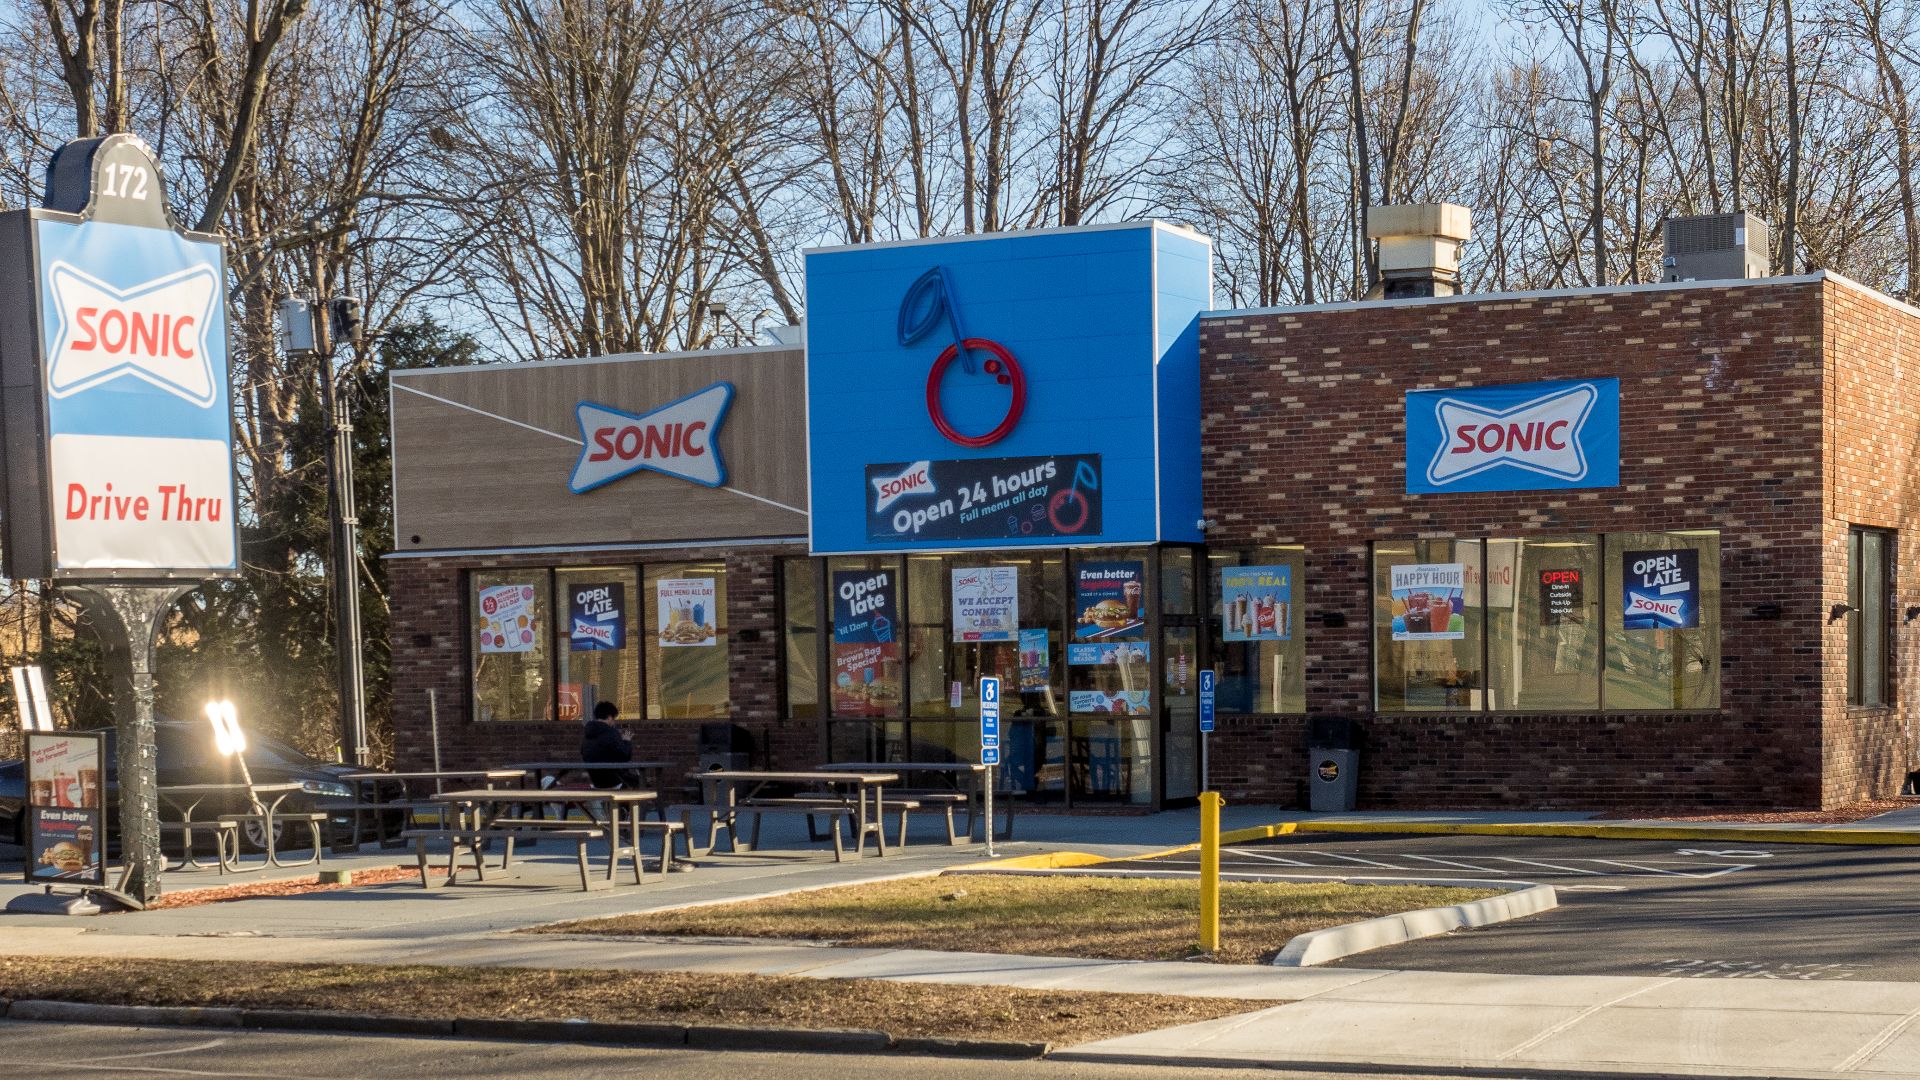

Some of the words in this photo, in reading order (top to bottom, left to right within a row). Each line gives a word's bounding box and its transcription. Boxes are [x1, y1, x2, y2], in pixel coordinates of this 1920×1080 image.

[102, 162, 149, 201] 172
[70, 307, 195, 360] SONIC
[588, 421, 707, 462] SONIC
[1451, 420, 1569, 455] SONIC
[880, 469, 928, 500] SONIC
[65, 482, 150, 522] Drive
[158, 483, 222, 523] Thru
[892, 498, 955, 534] Open
[957, 481, 988, 511] 24
[991, 460, 1057, 498] hours
[959, 509, 980, 524] Full
[981, 501, 1010, 517] menu
[1012, 492, 1027, 506] all
[1028, 485, 1049, 502] day
[1632, 554, 1677, 575] OPEN
[958, 576, 978, 586] SONIC
[1080, 570, 1103, 580] Even
[1104, 569, 1135, 579] better
[1258, 576, 1287, 586] REAL
[1396, 573, 1430, 587] HAPPY
[1432, 571, 1460, 585] HOUR
[1541, 571, 1580, 585] OPEN
[1643, 568, 1682, 588] LATE
[576, 586, 609, 605] OPEN
[660, 589, 674, 598] FULL
[674, 588, 690, 596] MENU
[690, 588, 701, 596] ALL
[701, 588, 713, 596] DAY
[839, 573, 888, 601] Open
[499, 602, 510, 610] ALL
[509, 597, 520, 605] DAY
[584, 599, 613, 616] LATE
[849, 594, 885, 617] late
[958, 597, 974, 606] WE
[975, 596, 1014, 605] ACCEPT
[1632, 599, 1678, 615] SONIC
[961, 608, 1009, 617] CONNECT
[577, 624, 610, 639] SONIC
[836, 652, 864, 667] Brown
[863, 646, 882, 657] Bag
[846, 655, 878, 673] Special
[40, 809, 61, 820] Even
[61, 811, 89, 822] better
